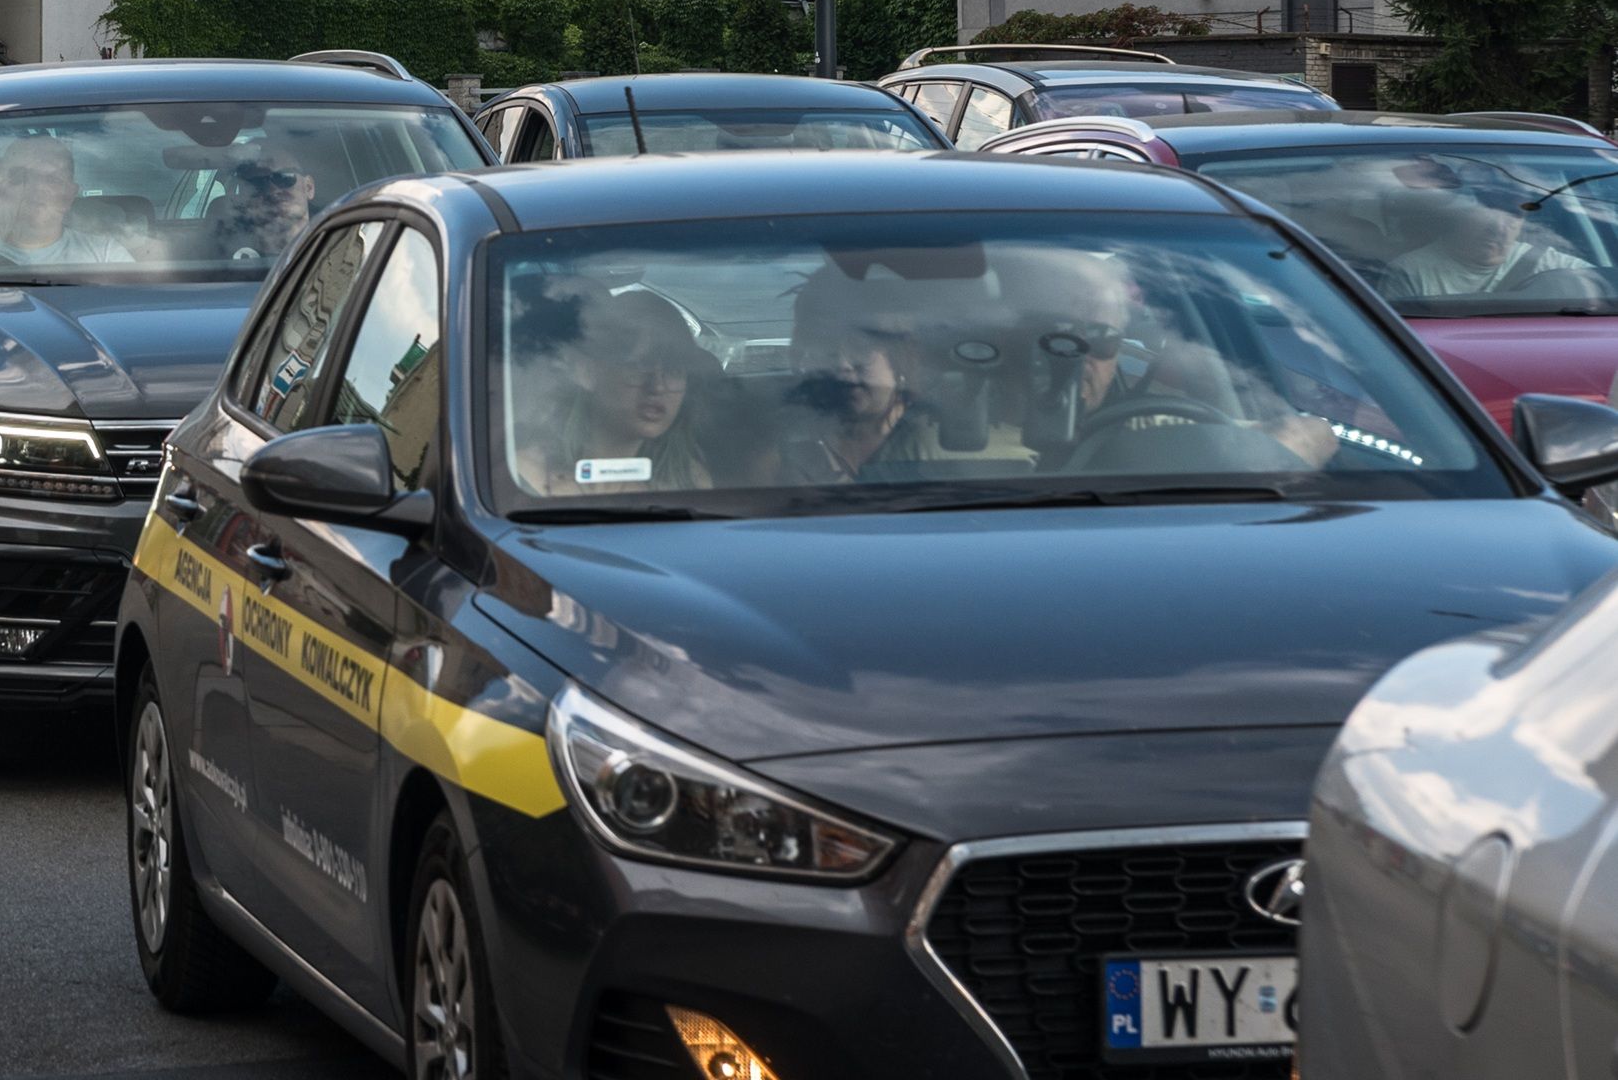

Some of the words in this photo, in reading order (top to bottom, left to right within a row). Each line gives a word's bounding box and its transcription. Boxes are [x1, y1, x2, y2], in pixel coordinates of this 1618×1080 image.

[174, 547, 212, 606] AGENCJA
[244, 596, 293, 659] OCHRONY
[301, 630, 375, 713] KOWALCZYK
[1112, 1014, 1138, 1034] PL
[1158, 967, 1251, 1039] WY
